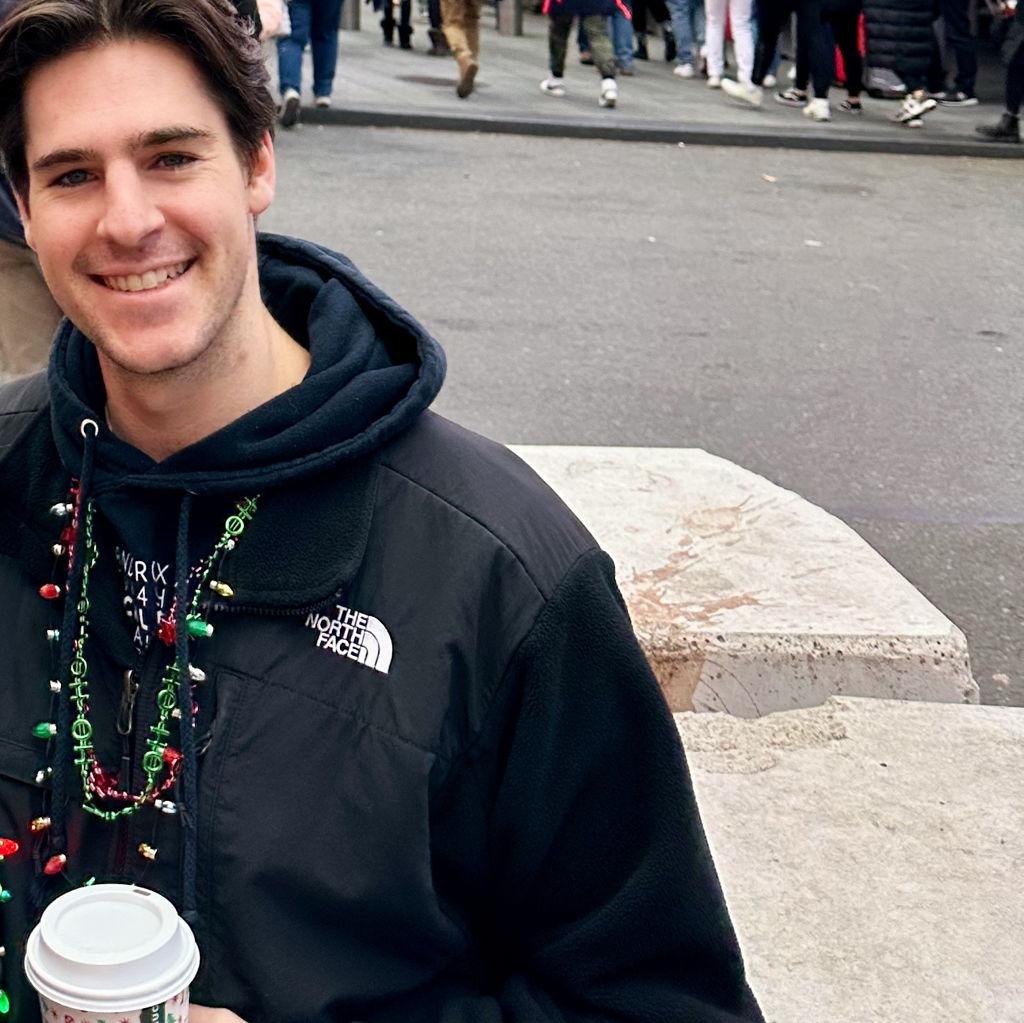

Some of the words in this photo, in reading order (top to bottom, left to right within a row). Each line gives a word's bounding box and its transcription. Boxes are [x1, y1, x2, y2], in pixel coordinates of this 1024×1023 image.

[305, 613, 365, 646] NORTH
[336, 604, 370, 630] THE
[316, 631, 362, 661] FACE
